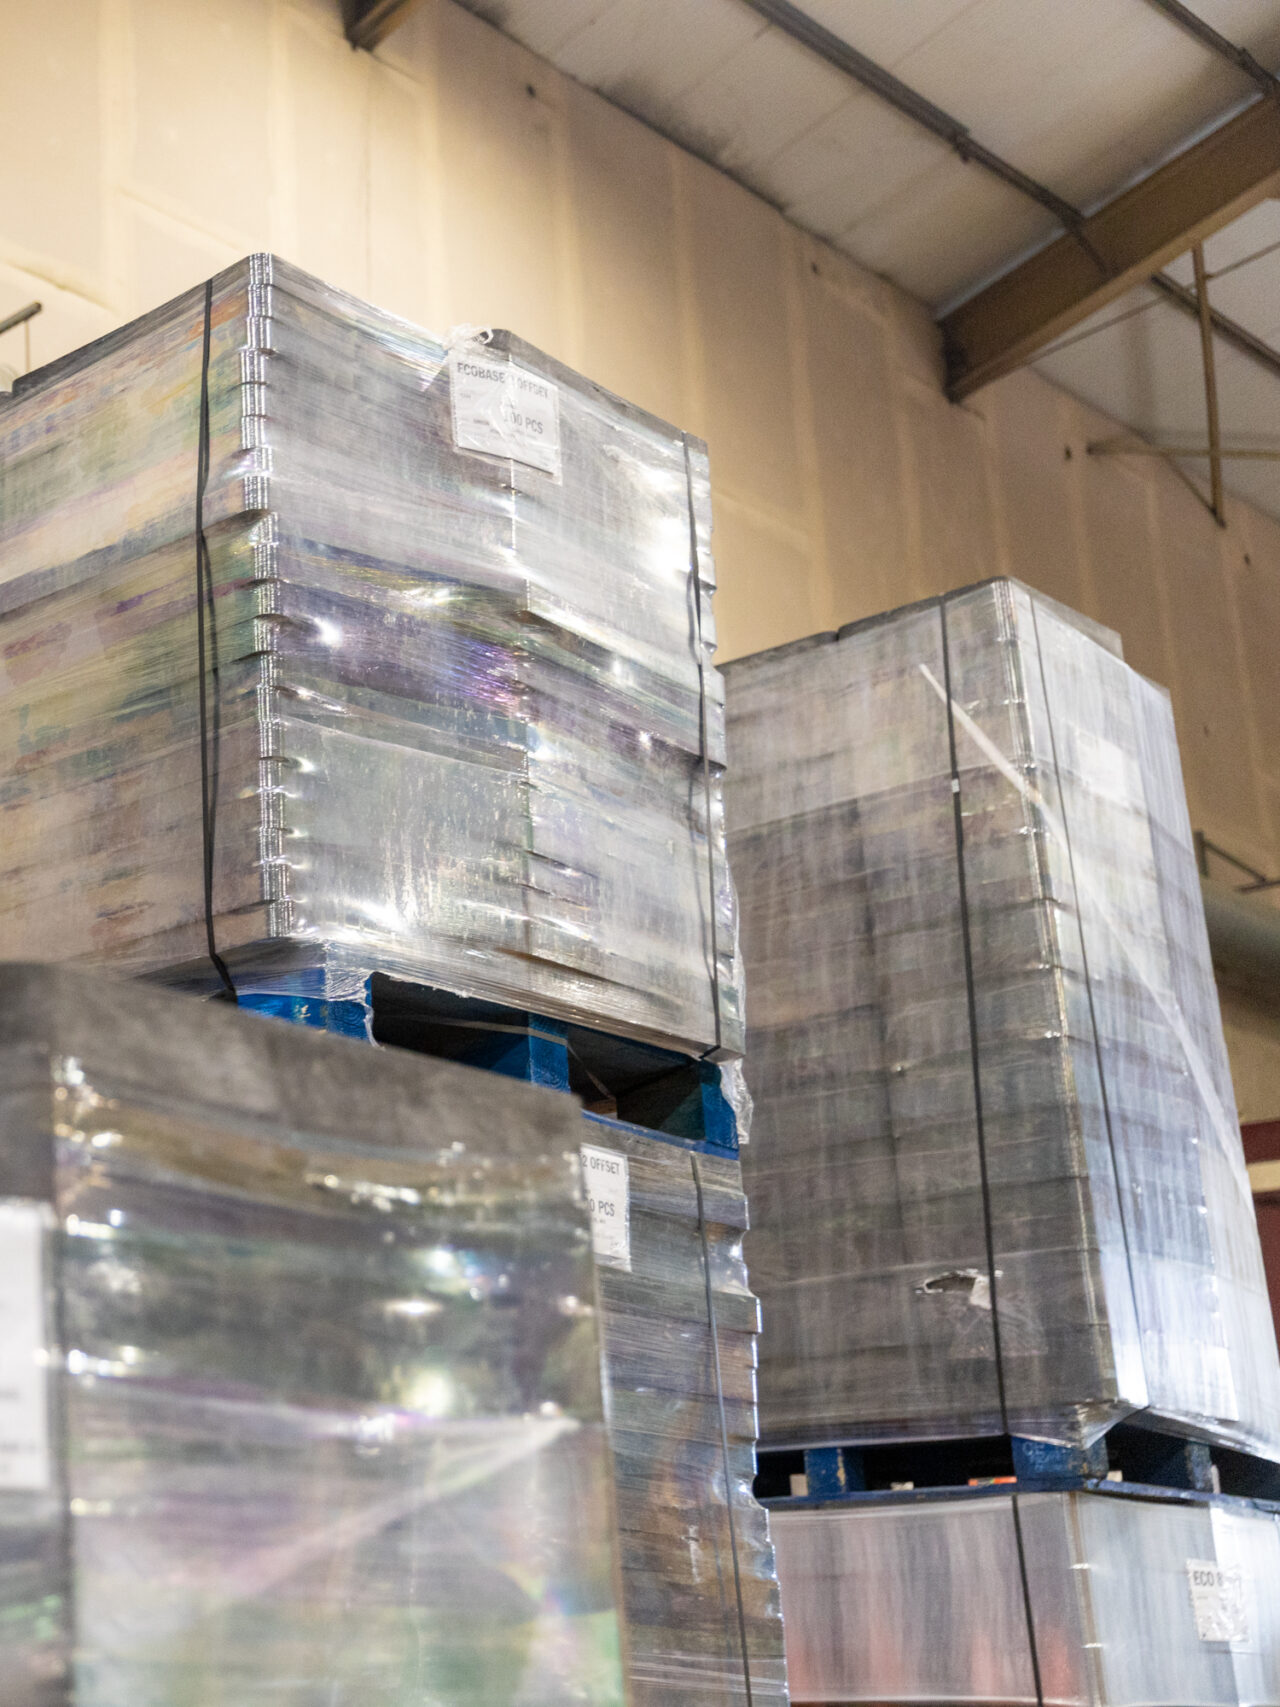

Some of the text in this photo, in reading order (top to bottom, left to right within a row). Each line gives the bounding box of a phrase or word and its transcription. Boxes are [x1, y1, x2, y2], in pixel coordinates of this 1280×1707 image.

[525, 416, 544, 434] PCS
[582, 1154, 620, 1175] 2 OFFSET
[598, 1200, 615, 1217] PCS
[1193, 1570, 1214, 1587] ECO
